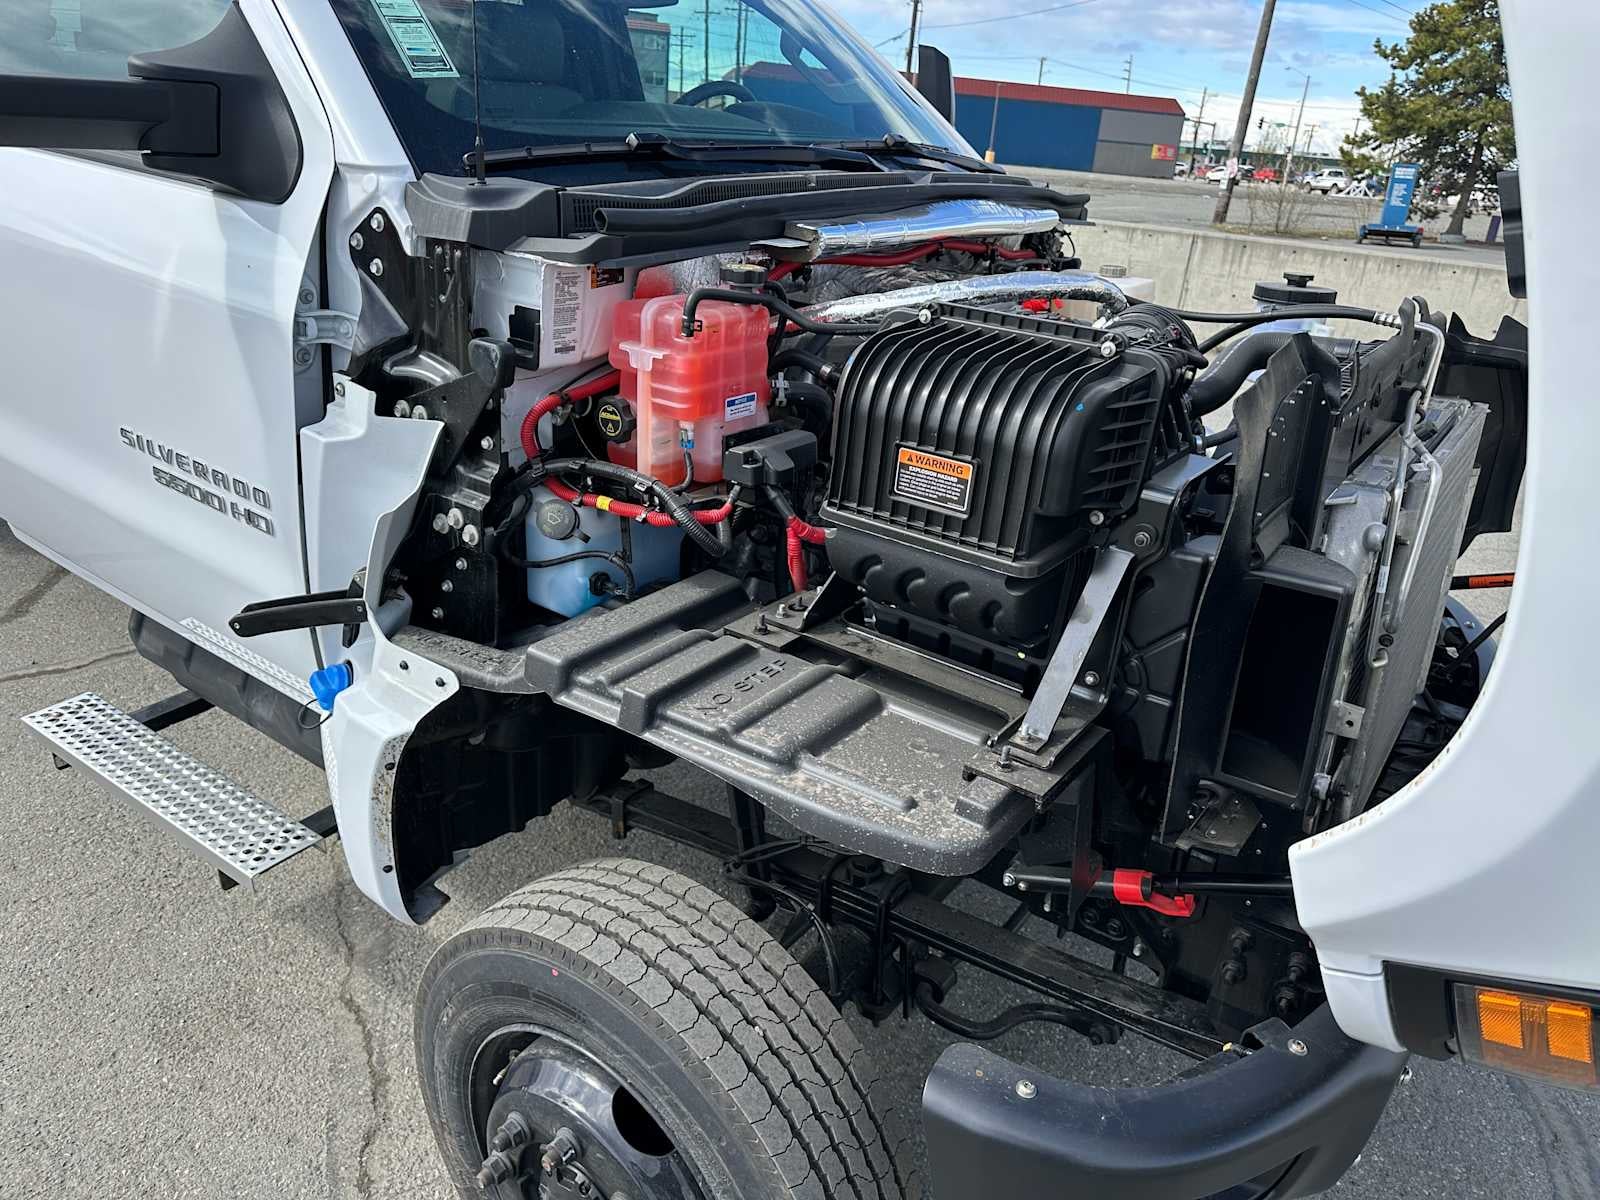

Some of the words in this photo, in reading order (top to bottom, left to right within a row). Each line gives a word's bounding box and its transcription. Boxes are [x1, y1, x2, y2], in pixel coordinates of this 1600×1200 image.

[120, 427, 271, 509] SILVERADO
[915, 454, 964, 475] WARNING
[152, 465, 227, 514] 5500
[230, 500, 274, 536] HD
[734, 659, 786, 692] STEP
